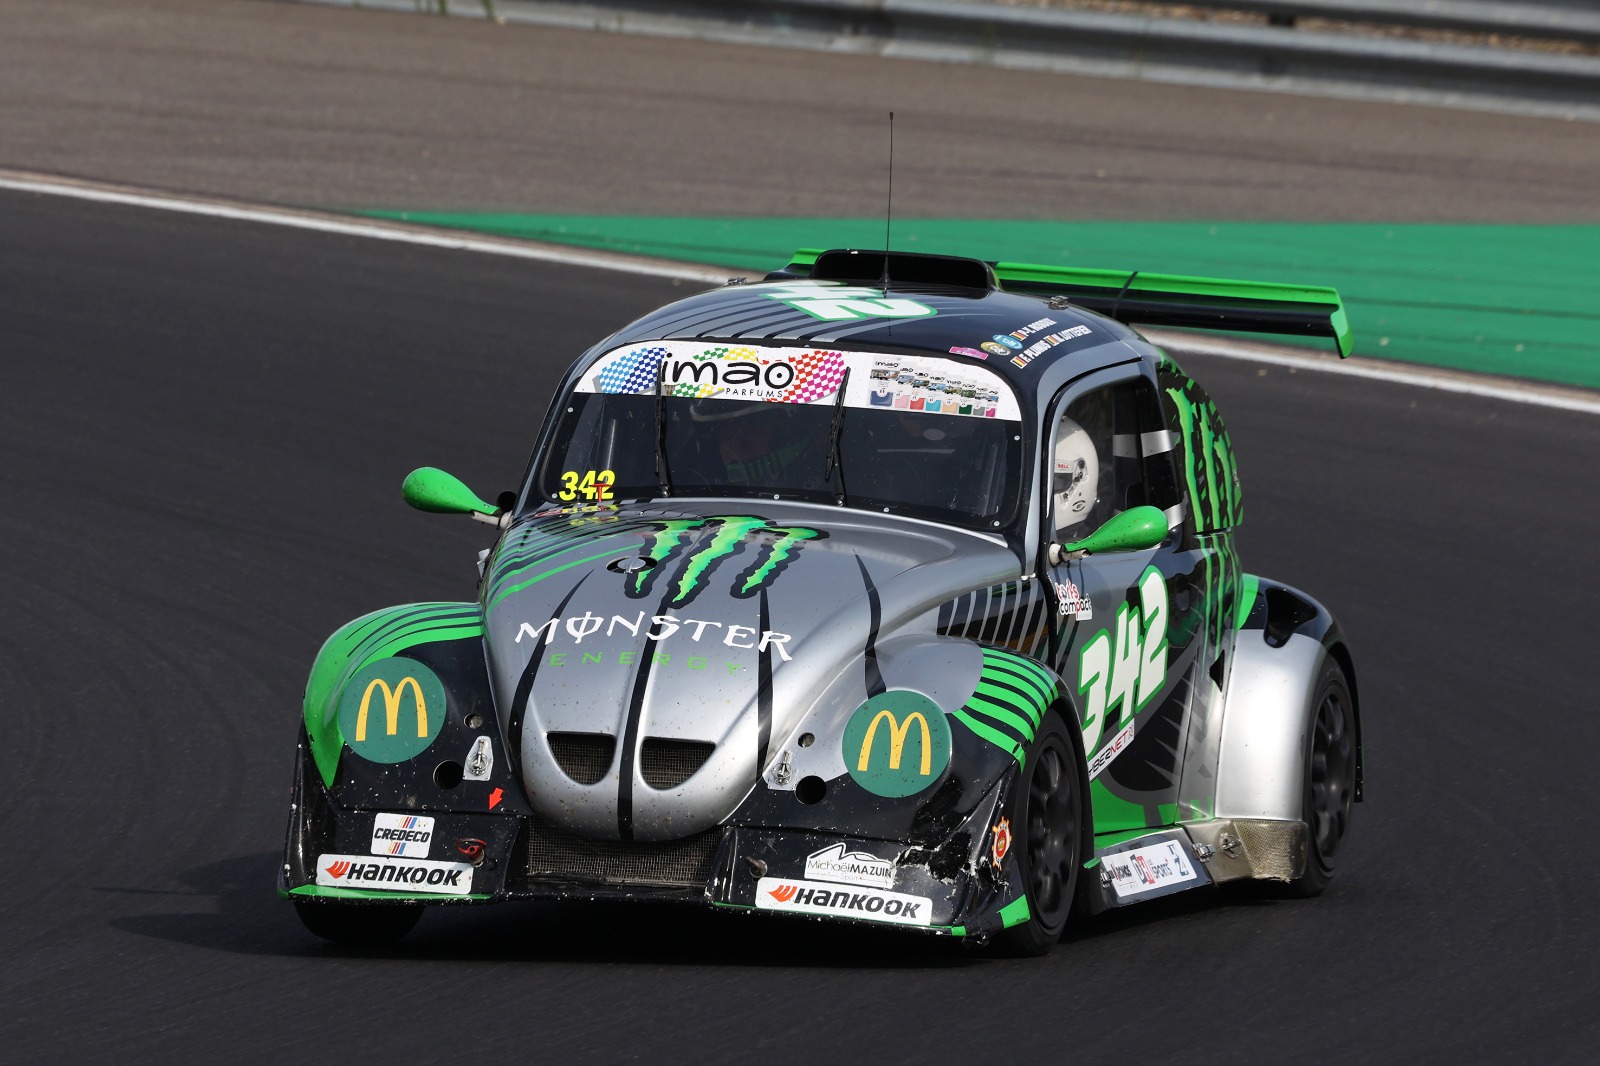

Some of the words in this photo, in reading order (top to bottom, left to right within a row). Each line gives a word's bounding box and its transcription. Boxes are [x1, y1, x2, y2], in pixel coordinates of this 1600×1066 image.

[726, 387, 783, 398] PARFUMS
[559, 470, 615, 501] 342
[550, 652, 742, 675] ENERGY
[1079, 565, 1168, 760] 342
[374, 828, 431, 843] CREDECO
